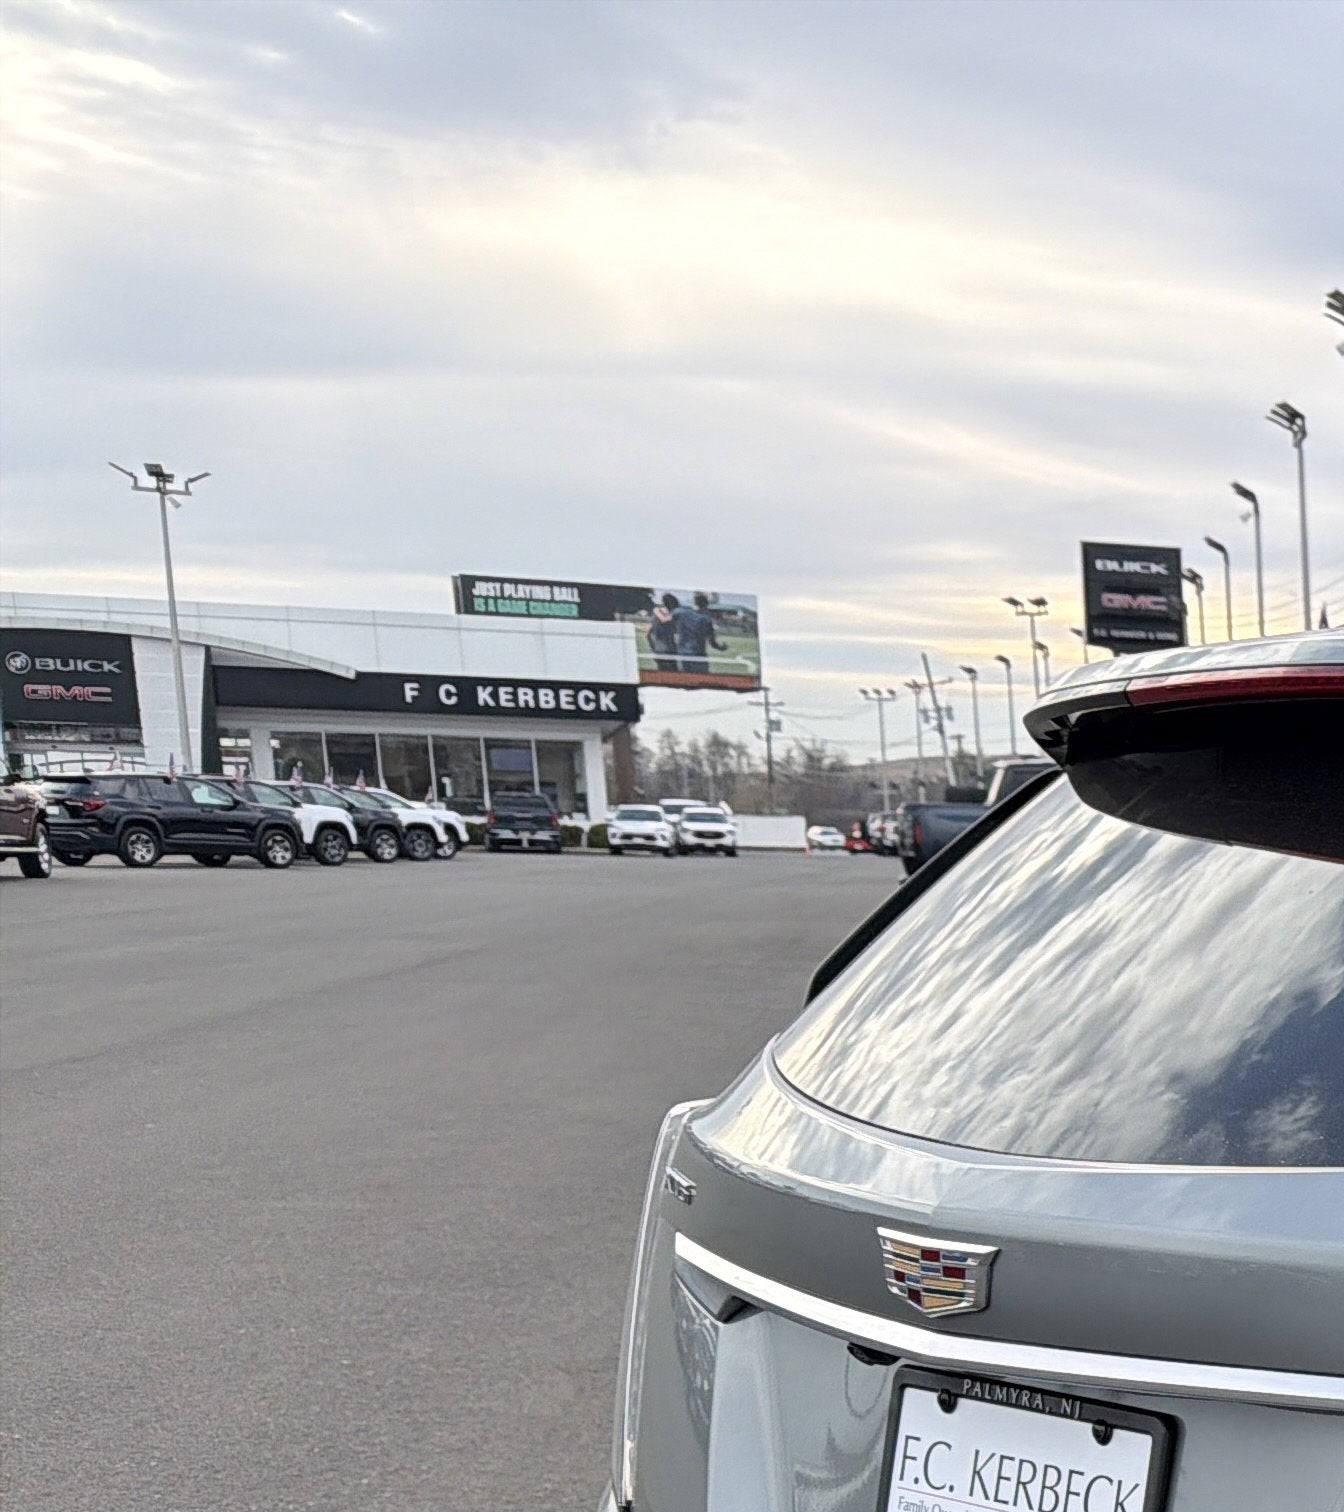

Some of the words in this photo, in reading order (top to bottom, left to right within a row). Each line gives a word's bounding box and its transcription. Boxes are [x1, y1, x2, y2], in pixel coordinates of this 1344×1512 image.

[1095, 559, 1169, 575] BUICK
[471, 580, 501, 598] JUST
[502, 582, 551, 601] PLAYING
[553, 585, 581, 603] BALL
[1101, 592, 1169, 611] GMC
[35, 657, 122, 674] BUICK
[23, 683, 113, 702] GMC
[403, 682, 420, 703] F
[438, 683, 458, 706] C
[476, 685, 619, 713] KERBECK
[1060, 1399, 1081, 1418] NJ
[898, 1434, 955, 1494] F.C.
